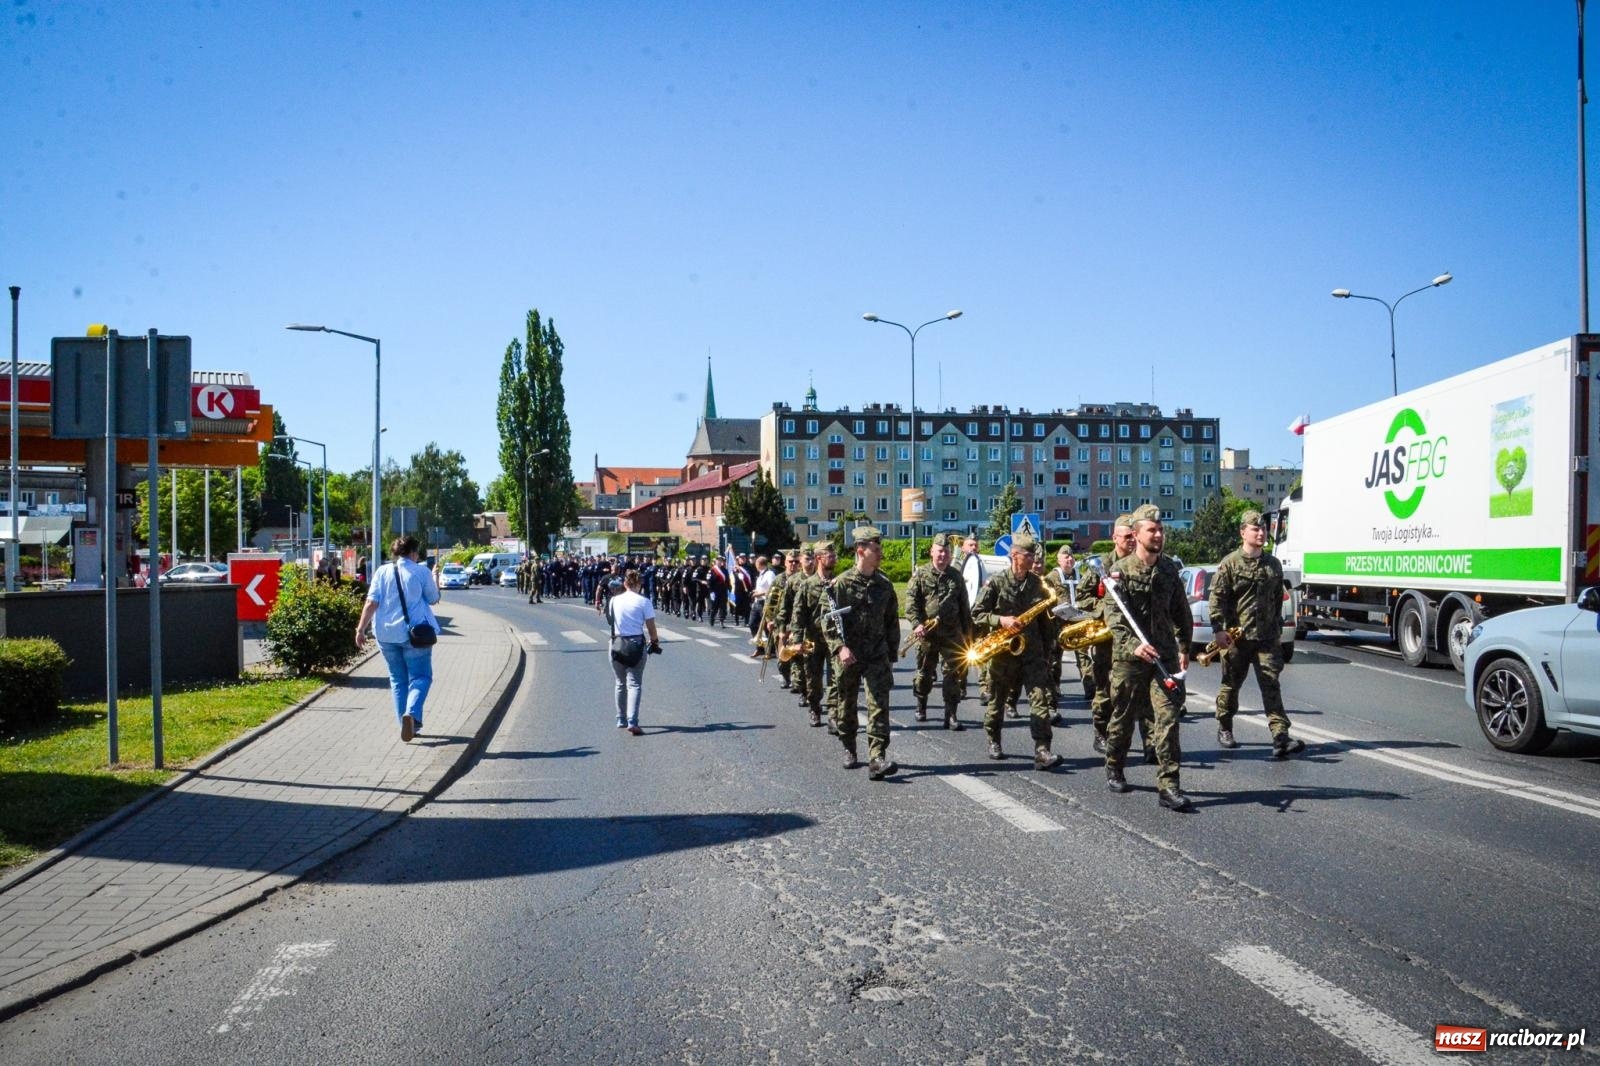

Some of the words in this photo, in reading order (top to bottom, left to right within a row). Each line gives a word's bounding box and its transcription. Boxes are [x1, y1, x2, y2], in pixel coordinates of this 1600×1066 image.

[207, 391, 232, 417] K
[115, 493, 134, 504] IR
[1372, 527, 1393, 544] Twoja
[1345, 555, 1393, 572] PRZESYŁKI
[1395, 554, 1473, 574] DROBNICOWE
